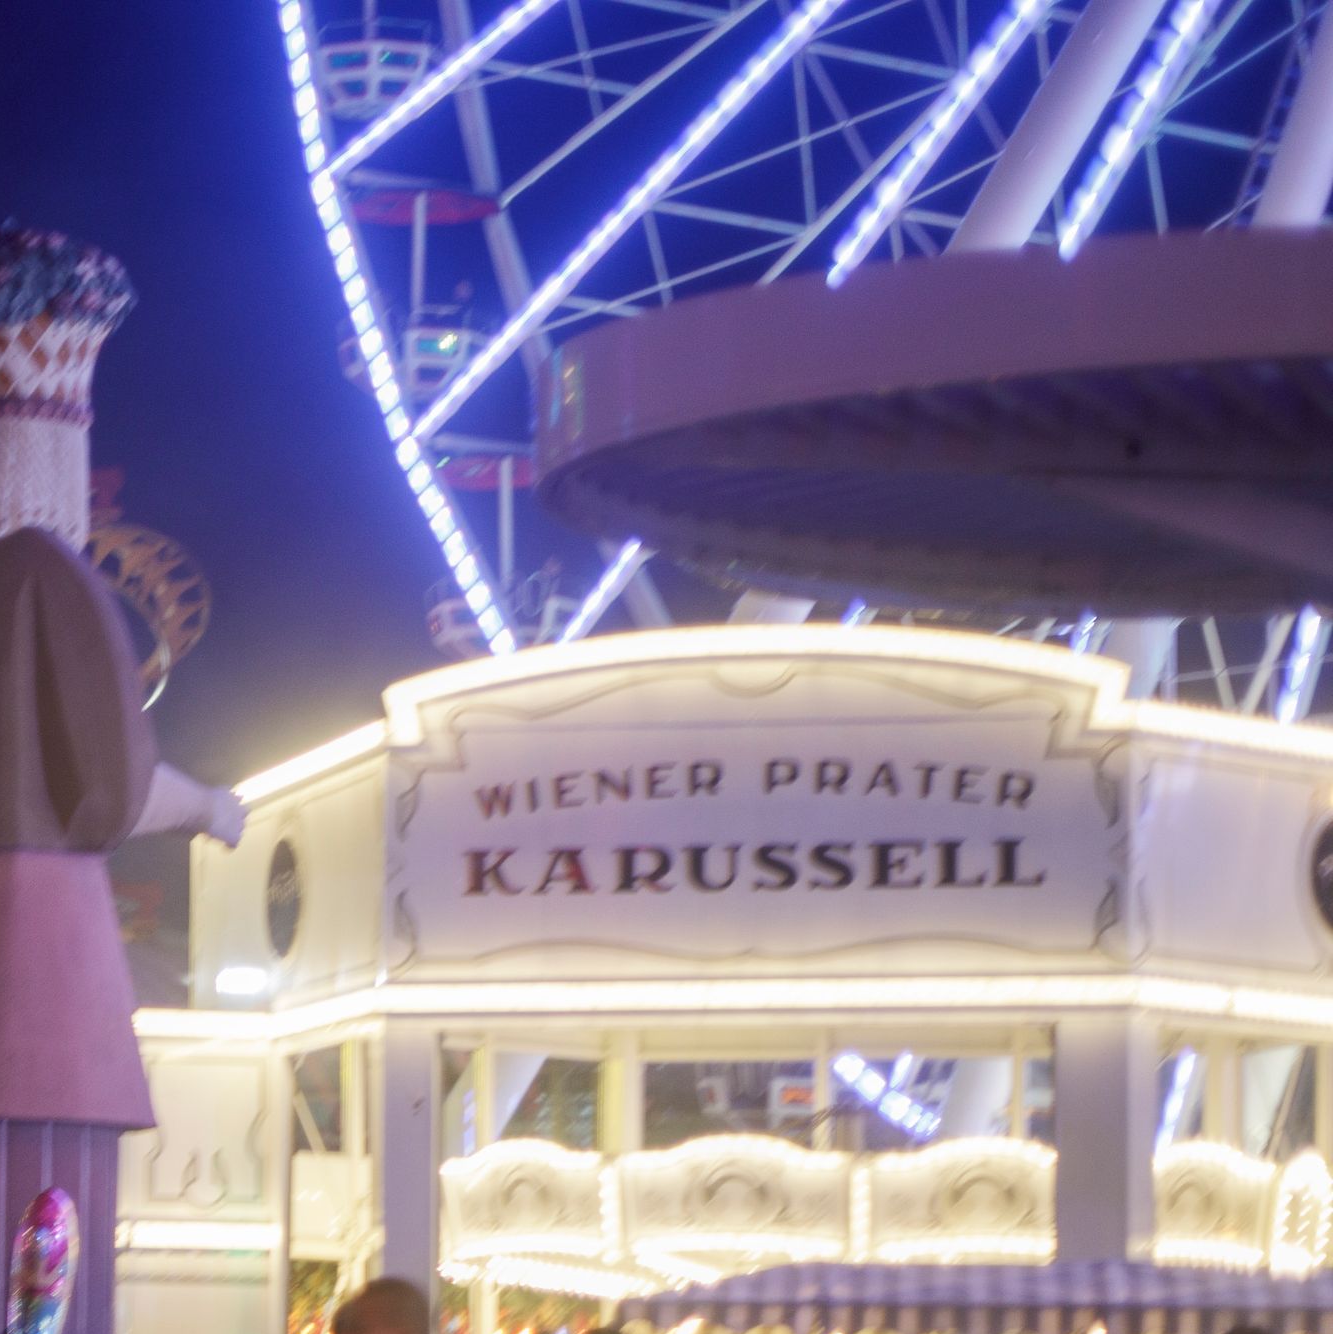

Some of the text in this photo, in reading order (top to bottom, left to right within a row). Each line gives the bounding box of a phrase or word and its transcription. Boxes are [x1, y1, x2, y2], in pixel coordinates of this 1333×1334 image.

[474, 757, 1038, 820] WIENER PRATER
[462, 837, 1047, 896] KARUSSELL
